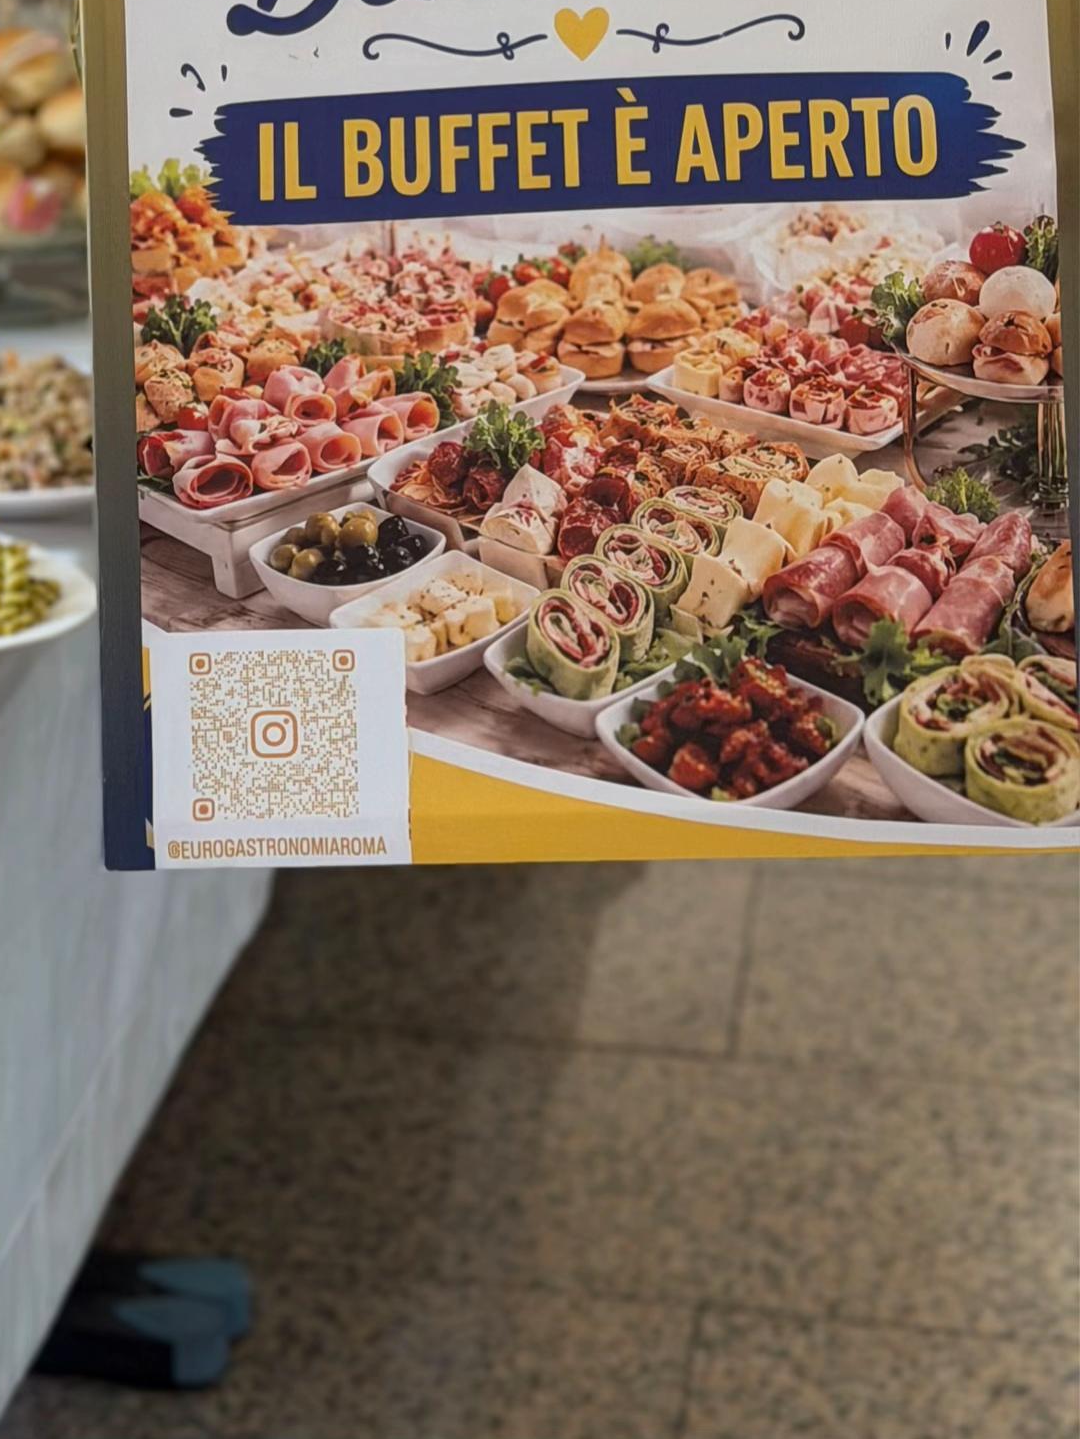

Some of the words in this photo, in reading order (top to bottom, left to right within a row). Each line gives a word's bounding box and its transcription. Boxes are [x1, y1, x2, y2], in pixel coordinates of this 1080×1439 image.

[257, 121, 318, 203] IL
[342, 107, 589, 199] BUFFET
[615, 86, 651, 187] È
[675, 93, 939, 189] APERTO
[166, 835, 388, 860] @EUROGASTRONOMIAROMA
